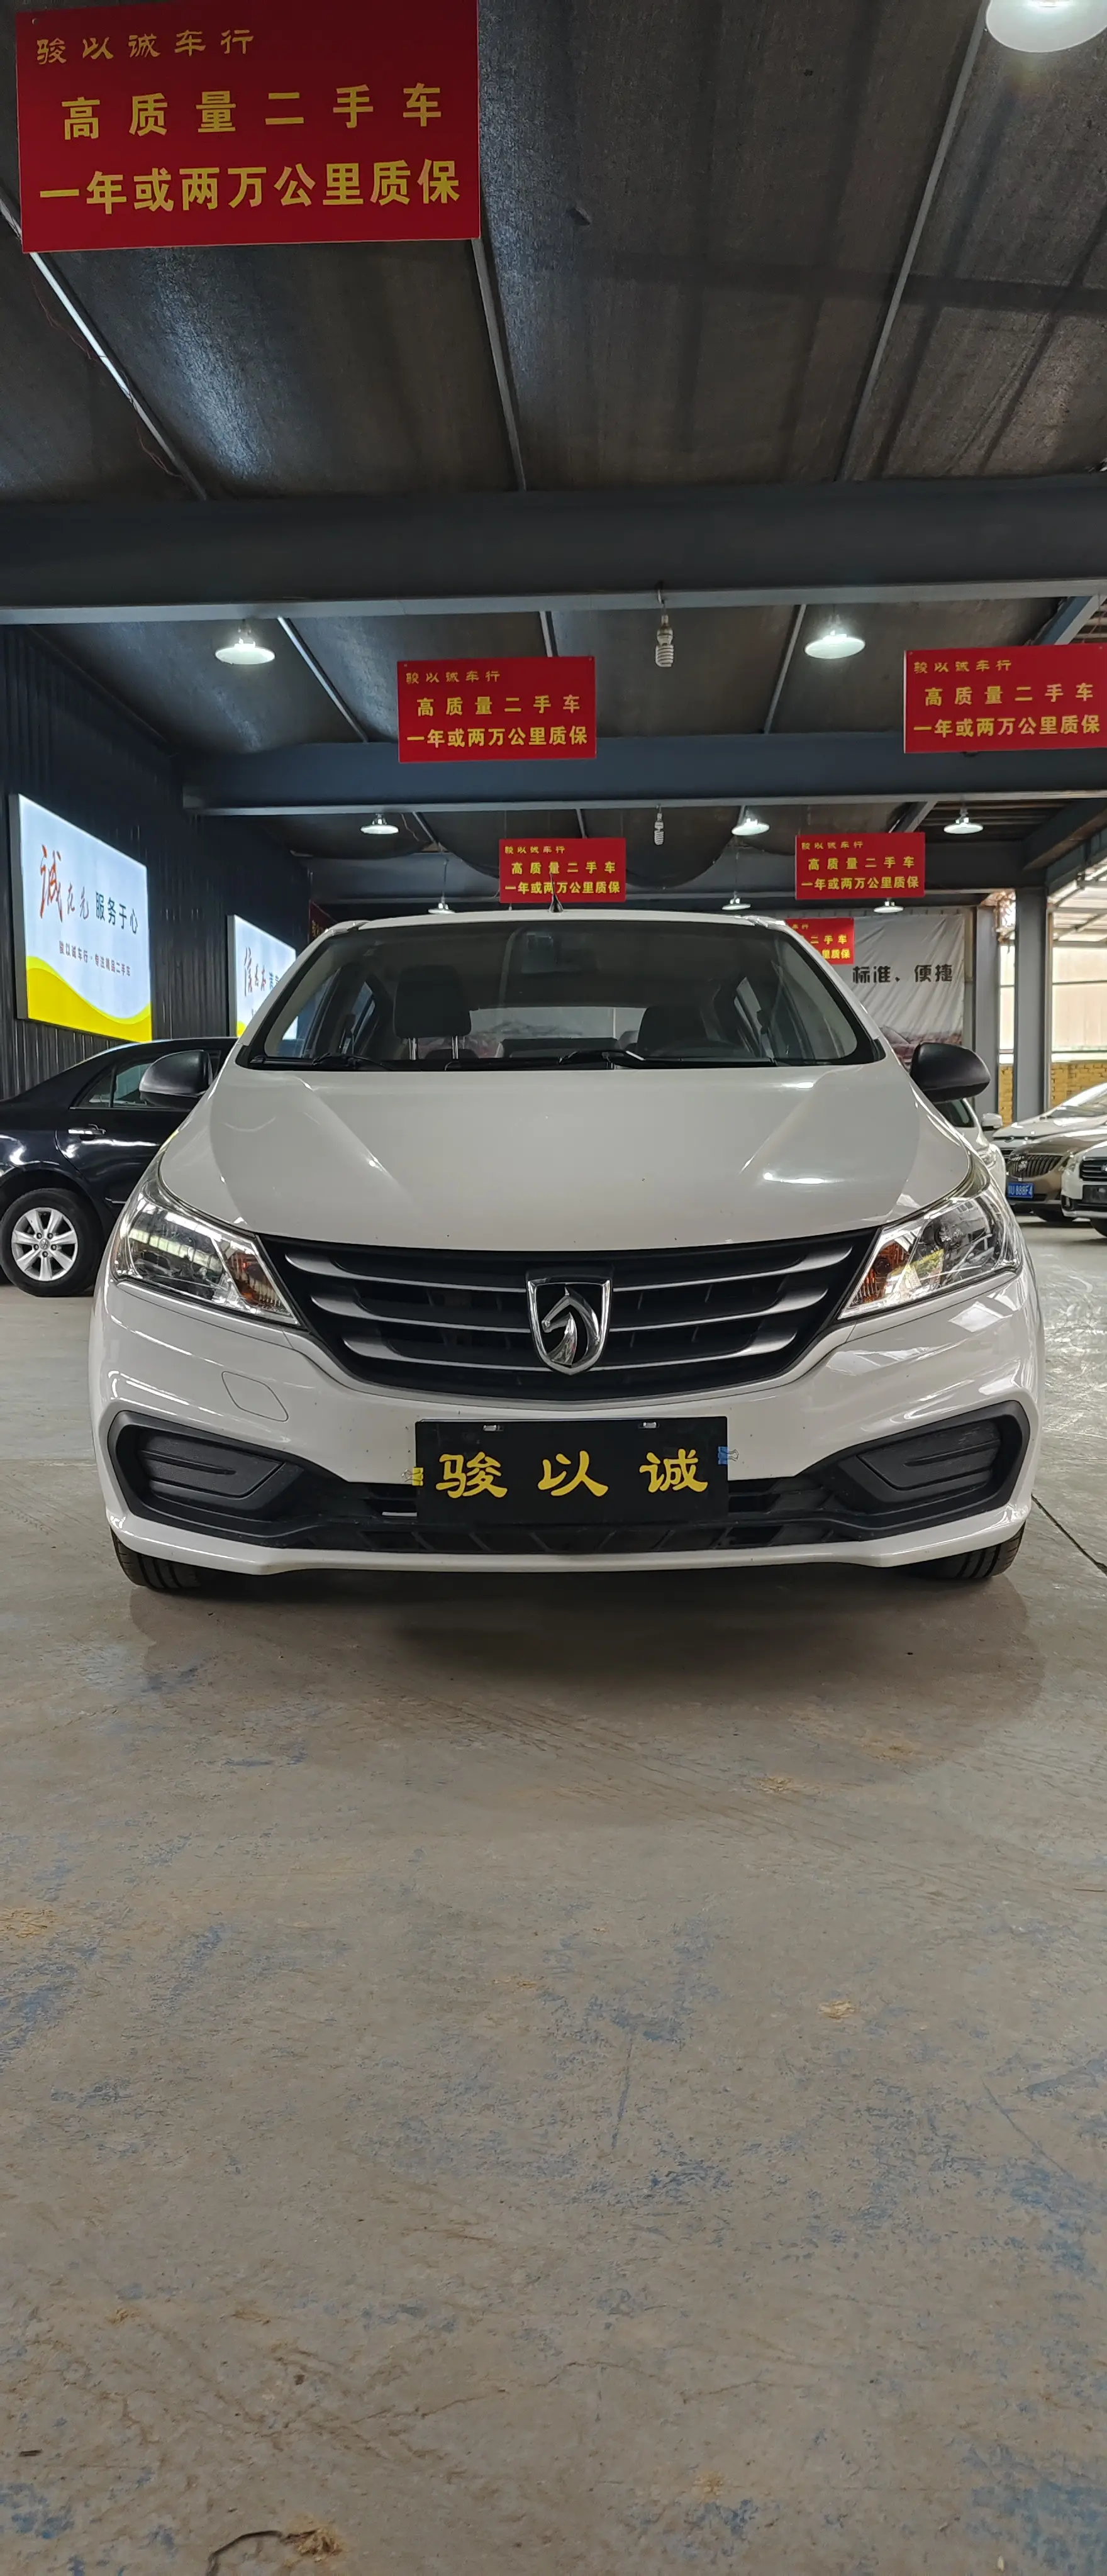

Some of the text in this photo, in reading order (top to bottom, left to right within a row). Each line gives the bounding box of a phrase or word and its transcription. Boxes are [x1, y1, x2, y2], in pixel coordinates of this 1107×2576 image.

[36, 29, 253, 65] 骏以诚车行
[62, 82, 442, 140] 高质量二手车
[40, 158, 460, 214] 一年或两万公里质保
[406, 670, 500, 684] 骏以诚车行
[417, 694, 580, 716] 高质量二手车
[924, 682, 1093, 706] 高质量二手车
[407, 726, 587, 748] 一年或两万公里质保
[913, 714, 1101, 738] 一年或两万公里质保
[511, 860, 616, 875] 高质量二手车
[808, 856, 915, 871] 高质量二手车
[505, 880, 620, 895] 一年或两万公里质保
[801, 876, 920, 891] 一年或两万公里质保
[96, 891, 138, 935] 服务于心
[852, 964, 953, 984] 标准、便捷
[436, 1448, 708, 1499] 骏以诚
